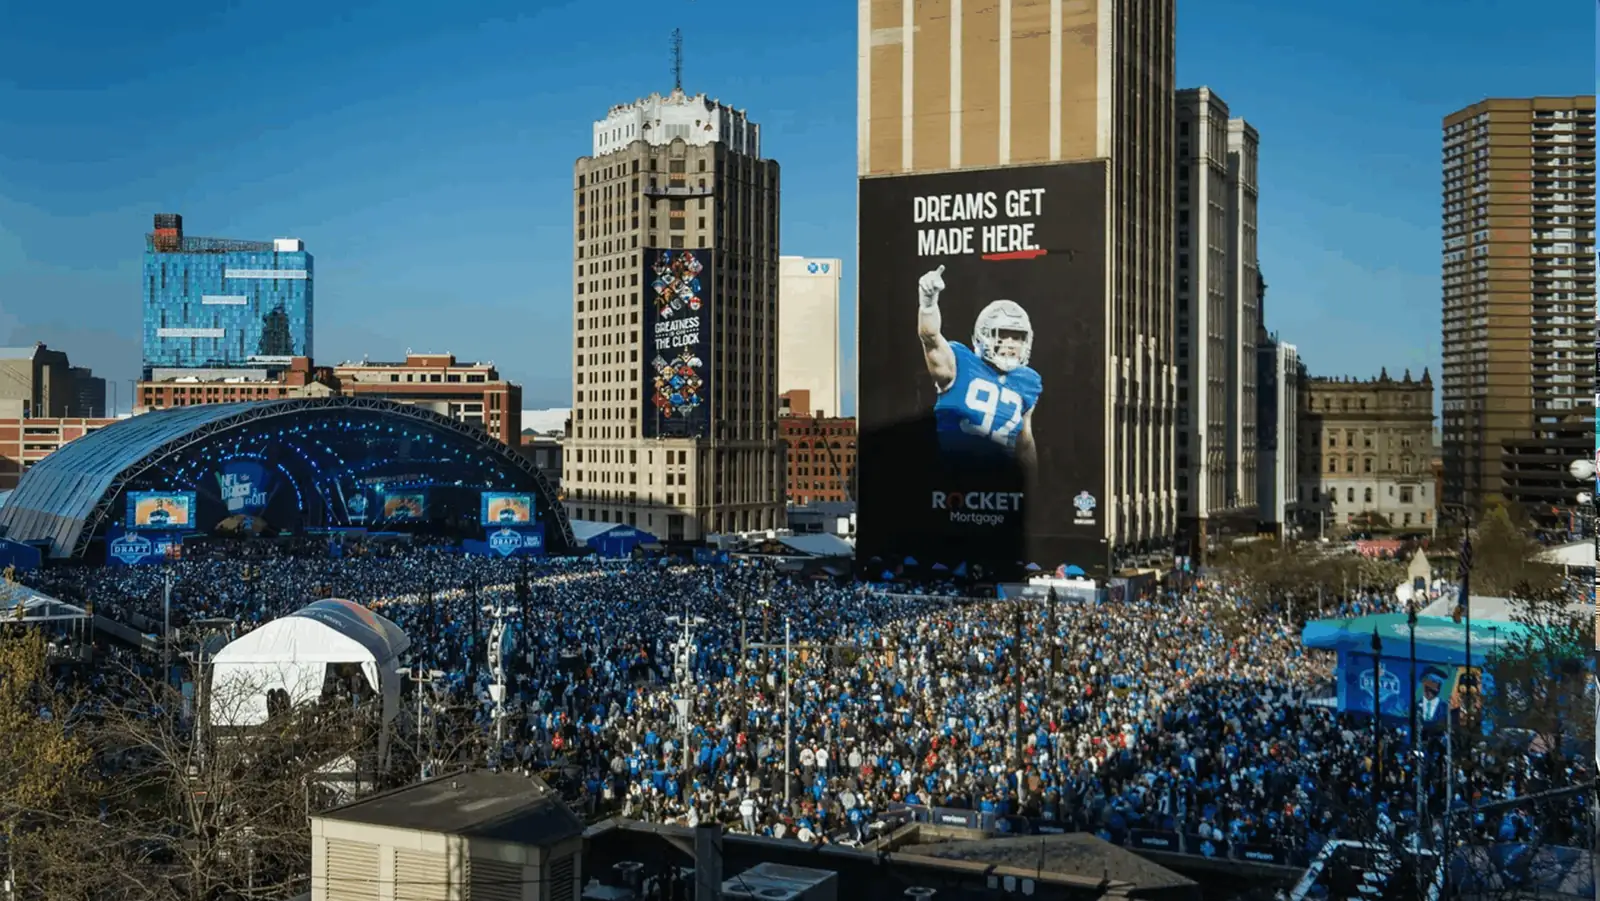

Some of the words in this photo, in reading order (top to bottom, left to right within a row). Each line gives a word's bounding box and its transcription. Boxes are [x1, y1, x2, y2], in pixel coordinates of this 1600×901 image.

[914, 191, 998, 223] DREAMS
[1005, 188, 1046, 218] GET
[918, 227, 975, 256] MADE
[982, 223, 1040, 253] HERE.
[655, 316, 700, 334] GREATNESS
[655, 337, 671, 350] THE
[672, 332, 700, 347] CLOCK
[959, 377, 1023, 447] 97
[931, 491, 1024, 511] ROCKET
[949, 511, 1005, 526] Mortgage
